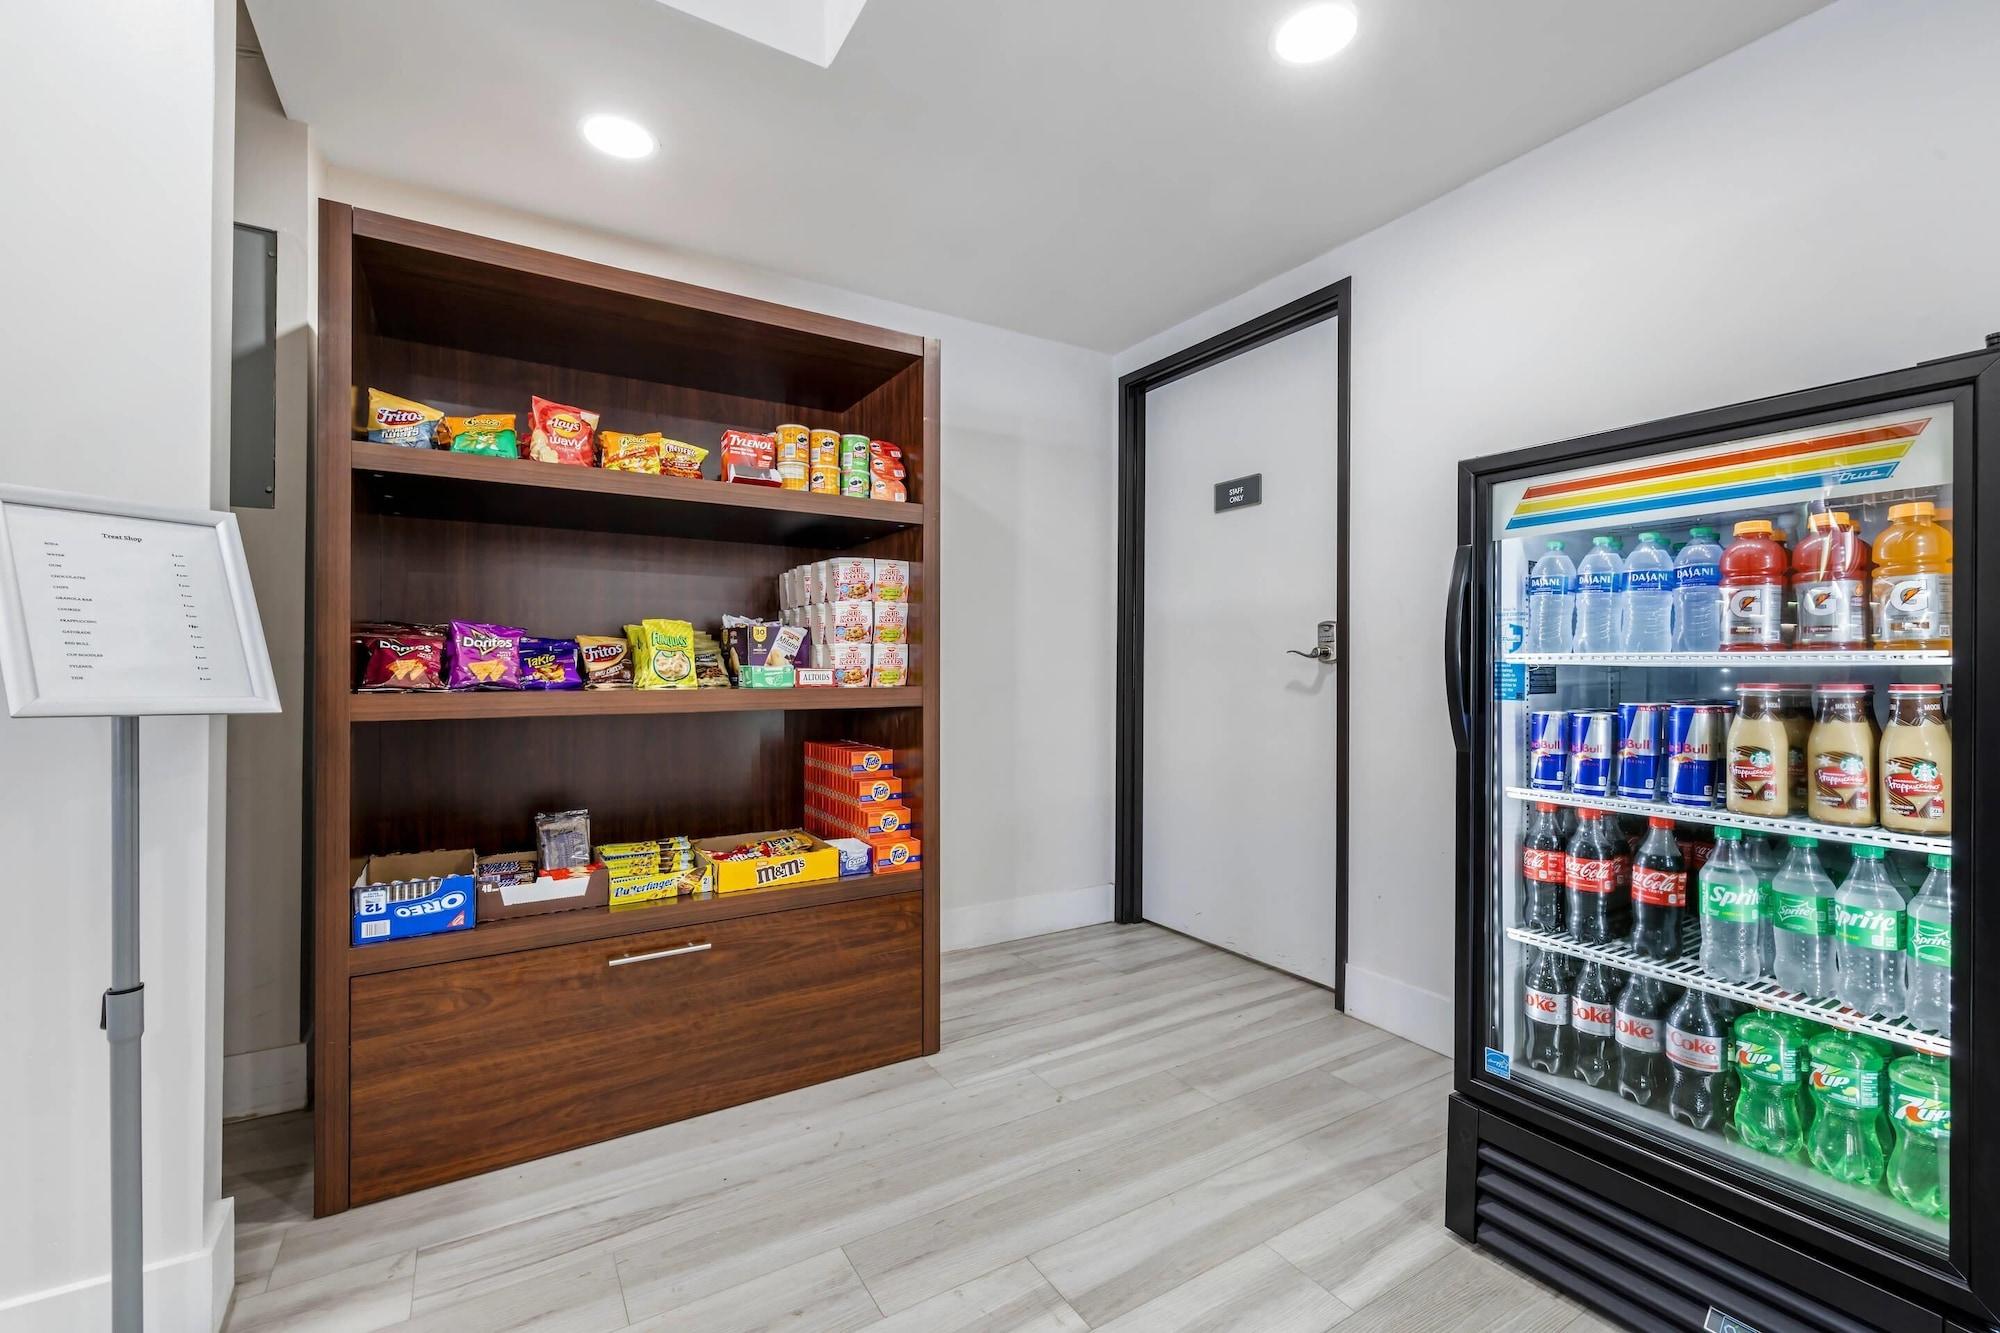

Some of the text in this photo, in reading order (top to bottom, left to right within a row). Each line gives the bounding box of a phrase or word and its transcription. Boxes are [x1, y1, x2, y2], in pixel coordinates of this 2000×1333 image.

[376, 408, 425, 423] Fritos
[730, 434, 773, 450] TYLENOL
[1229, 486, 1244, 496] STAFF
[1229, 494, 1244, 504] ONLY
[101, 533, 142, 543] Treat Shop
[1632, 571, 1668, 583] DASANI
[1677, 566, 1714, 579] DASANI
[1531, 578, 1561, 587] DASANI
[1579, 575, 1611, 585] DASANI
[463, 636, 512, 652] Doritos
[779, 634, 799, 650] Milano
[582, 644, 623, 662] Fritos
[803, 673, 830, 681] ALTOIDS
[1541, 740, 1560, 750] Bull
[1583, 743, 1603, 753] Bull
[1626, 740, 1650, 750] Bull
[1682, 743, 1709, 754] Bull
[865, 755, 880, 768] Tide
[873, 785, 889, 798] Tide
[882, 816, 898, 829] Tide
[891, 848, 907, 861] Tide
[365, 903, 383, 913] 12
[396, 891, 466, 918] OREO
[1780, 905, 1809, 917] Sprite
[1914, 932, 1950, 946] Sprite
[1616, 1019, 1654, 1039] oke
[1671, 1031, 1716, 1055] Coke
